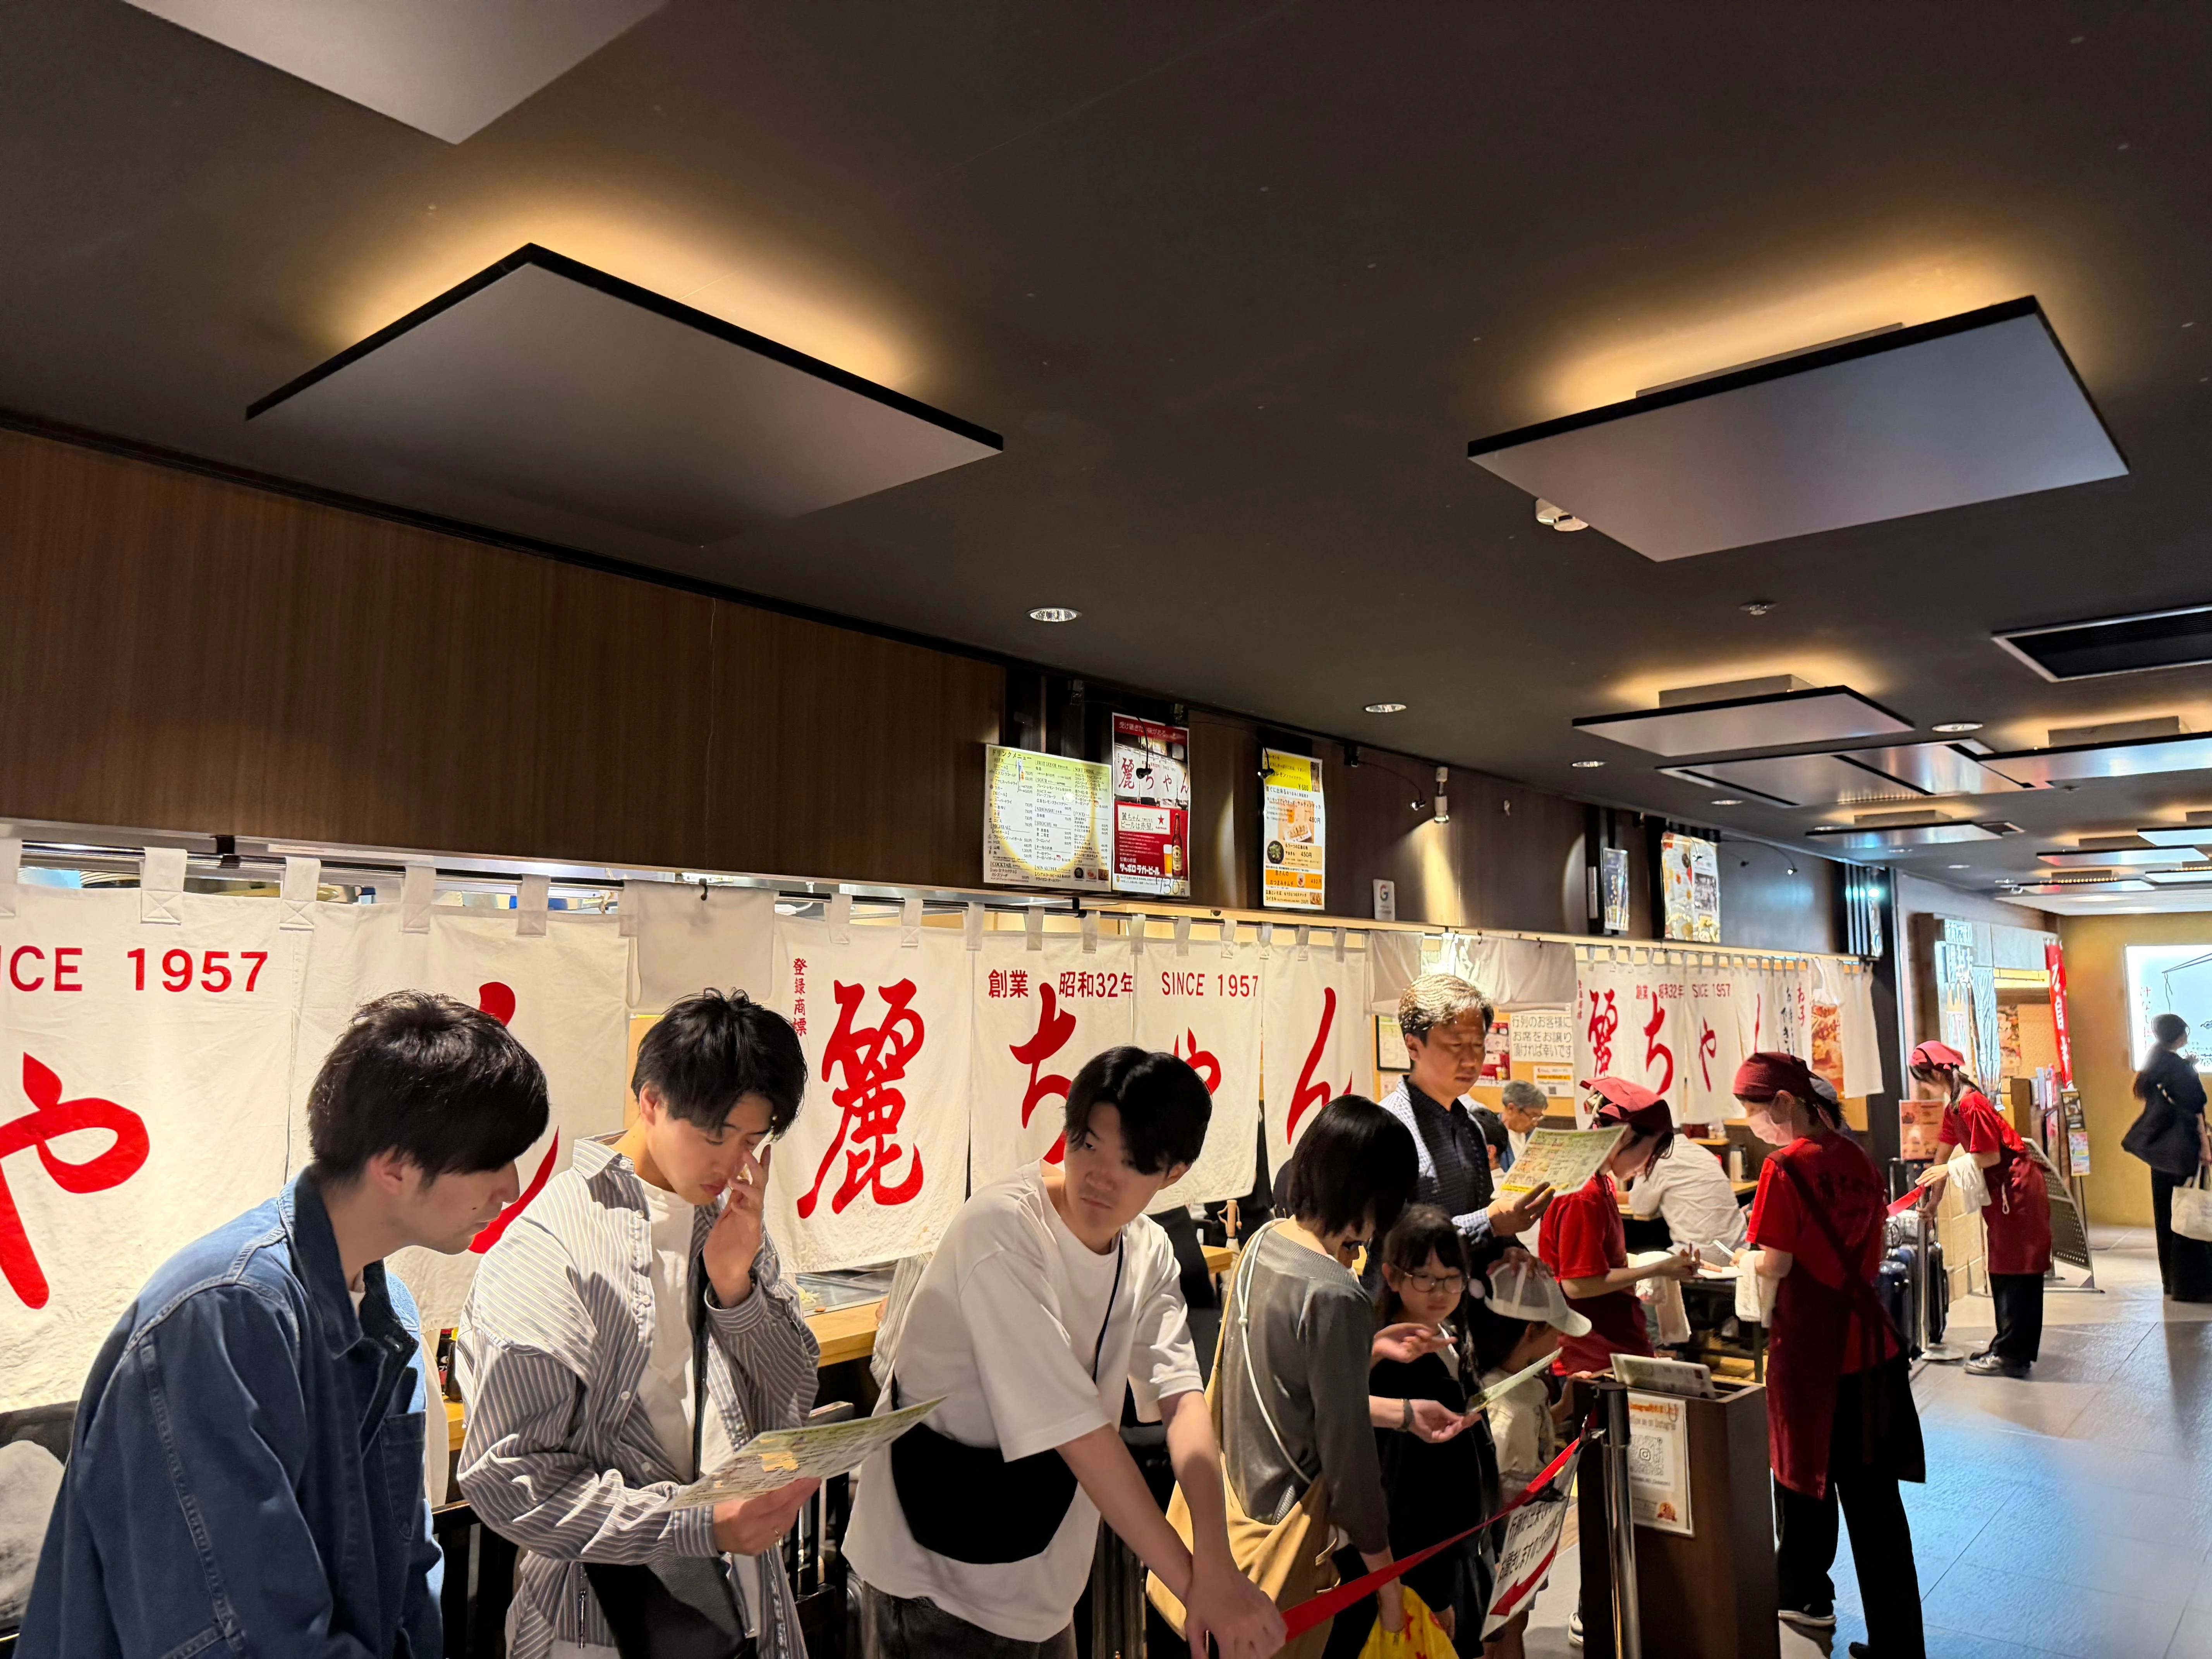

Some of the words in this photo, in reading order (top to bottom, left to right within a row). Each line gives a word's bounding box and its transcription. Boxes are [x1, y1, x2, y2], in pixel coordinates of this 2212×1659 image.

[993, 749, 1032, 760] ドリンクメニュー
[1121, 821, 1154, 831] ビールは赤星。
[1309, 816, 1321, 824] 480円
[0, 945, 82, 992] CE
[127, 948, 268, 993] 1957
[988, 969, 1029, 999] 創業
[1059, 971, 1133, 998] 昭和32年
[1161, 971, 1205, 997] SINCE
[1218, 974, 1259, 998] 1957
[1712, 983, 1731, 997] 1957
[793, 958, 808, 1036] 登録商標
[1512, 1015, 1572, 1028] 行列のお客様に
[1513, 1031, 1572, 1043] お席をお譲り
[1513, 1043, 1572, 1058] 頂ければ幸いです
